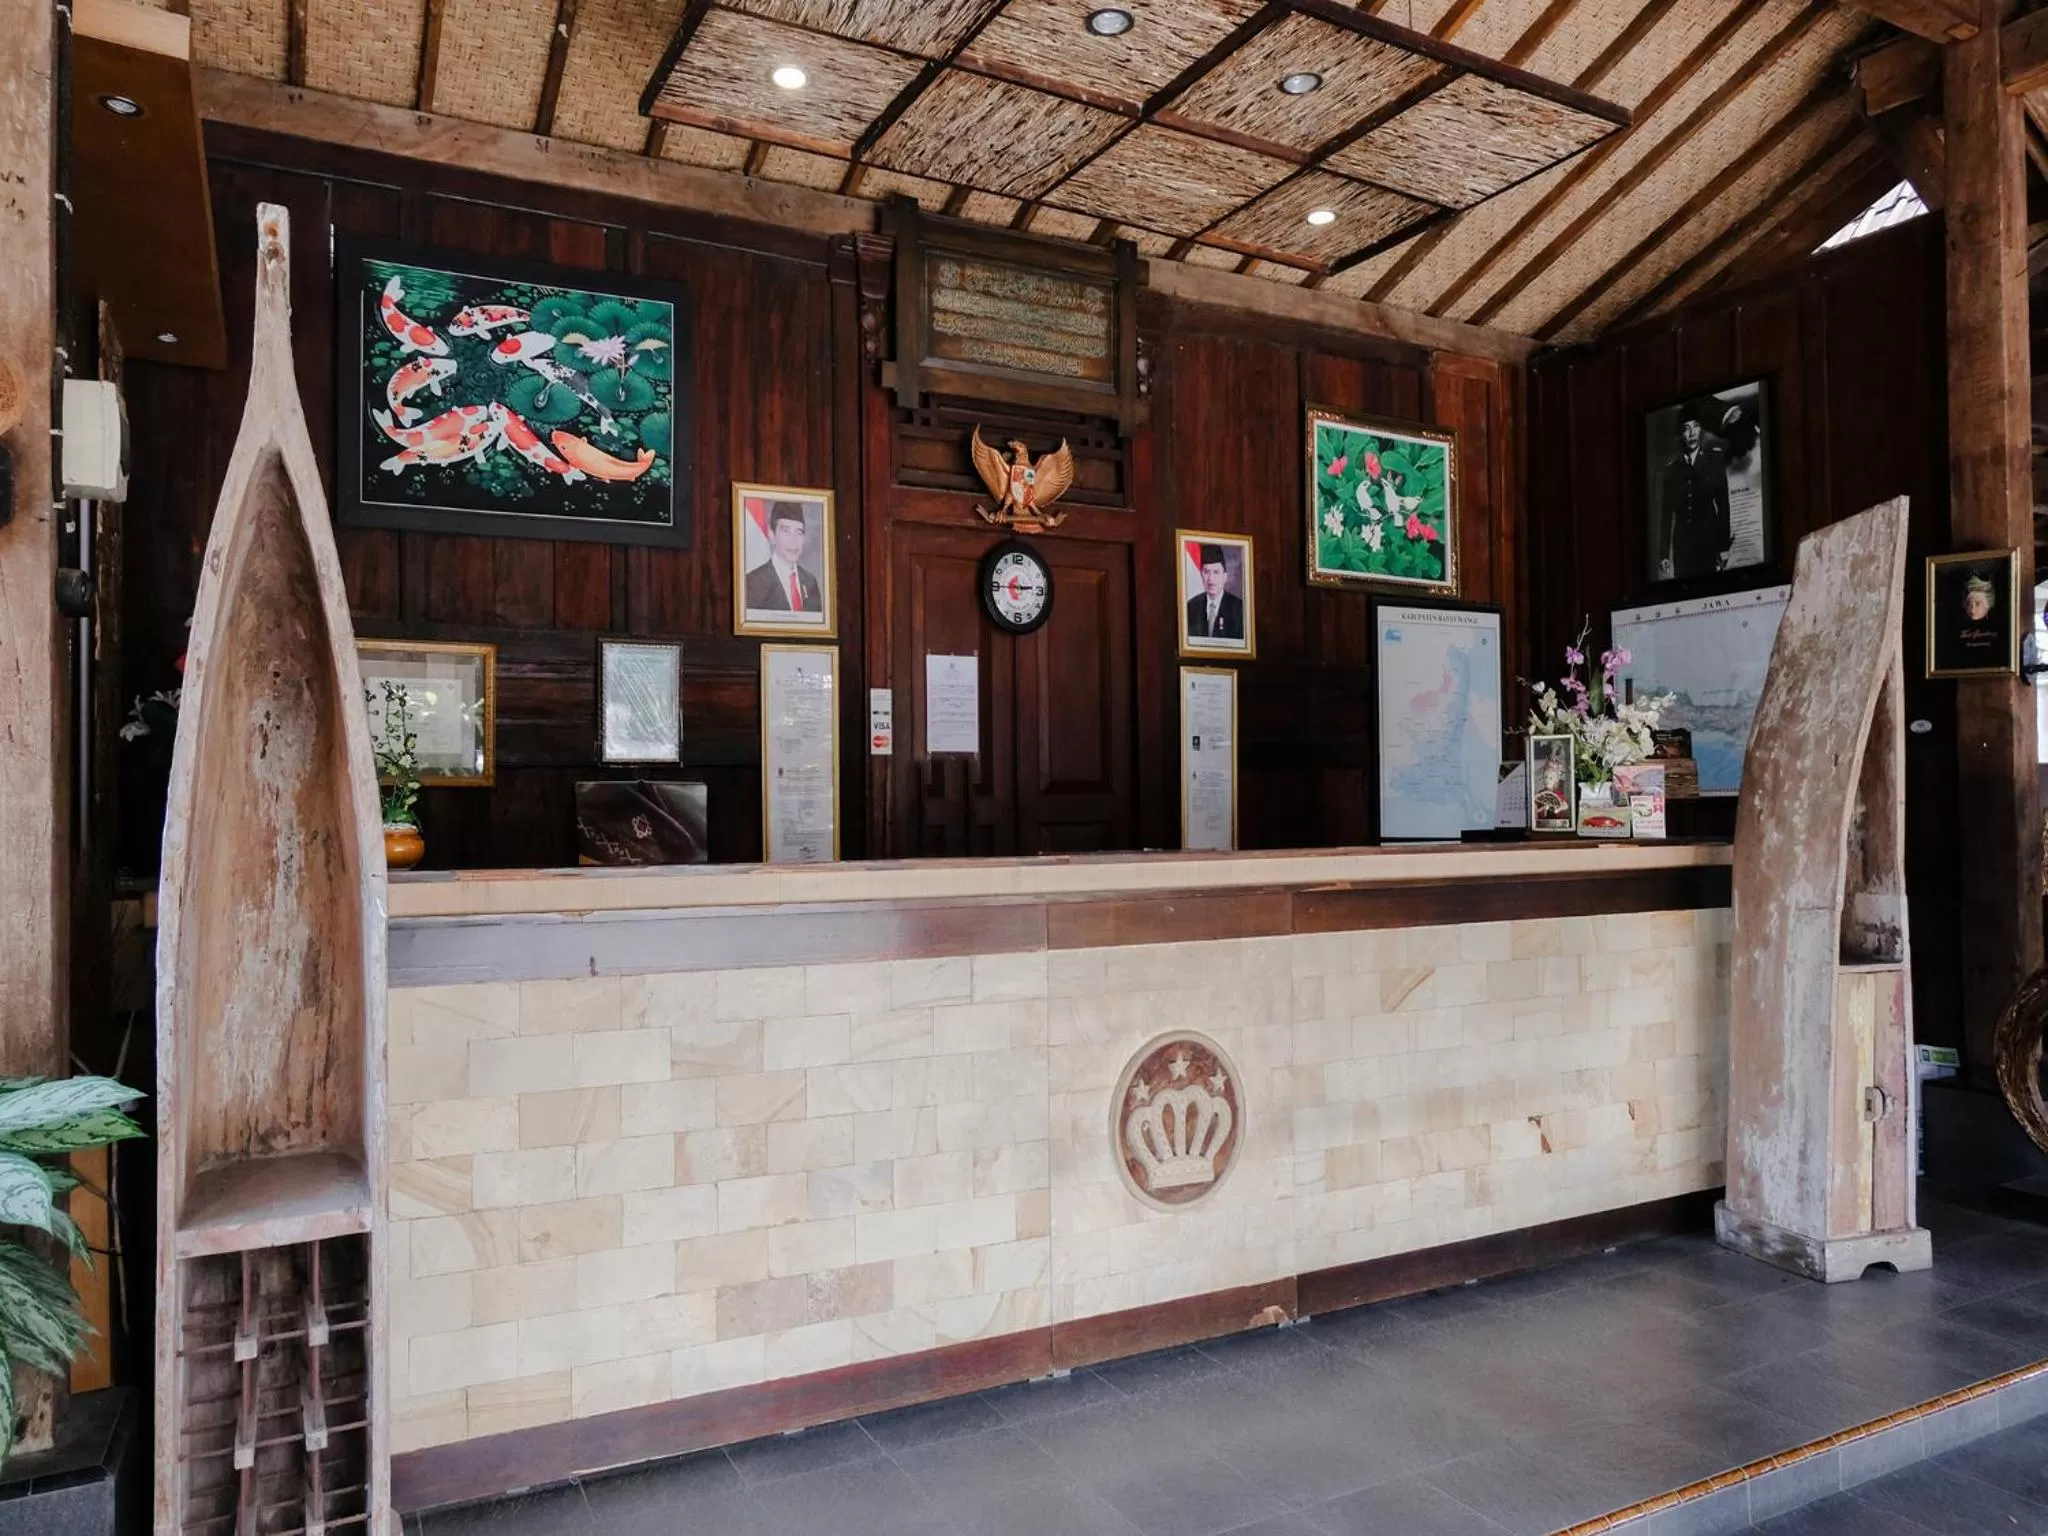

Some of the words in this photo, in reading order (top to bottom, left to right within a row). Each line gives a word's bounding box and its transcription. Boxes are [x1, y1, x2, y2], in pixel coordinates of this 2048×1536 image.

[1012, 554, 1023, 565] 12
[992, 581, 1000, 592] 9
[1036, 586, 1043, 596] 3
[1014, 612, 1022, 623] 6
[874, 722, 890, 730] VISA
